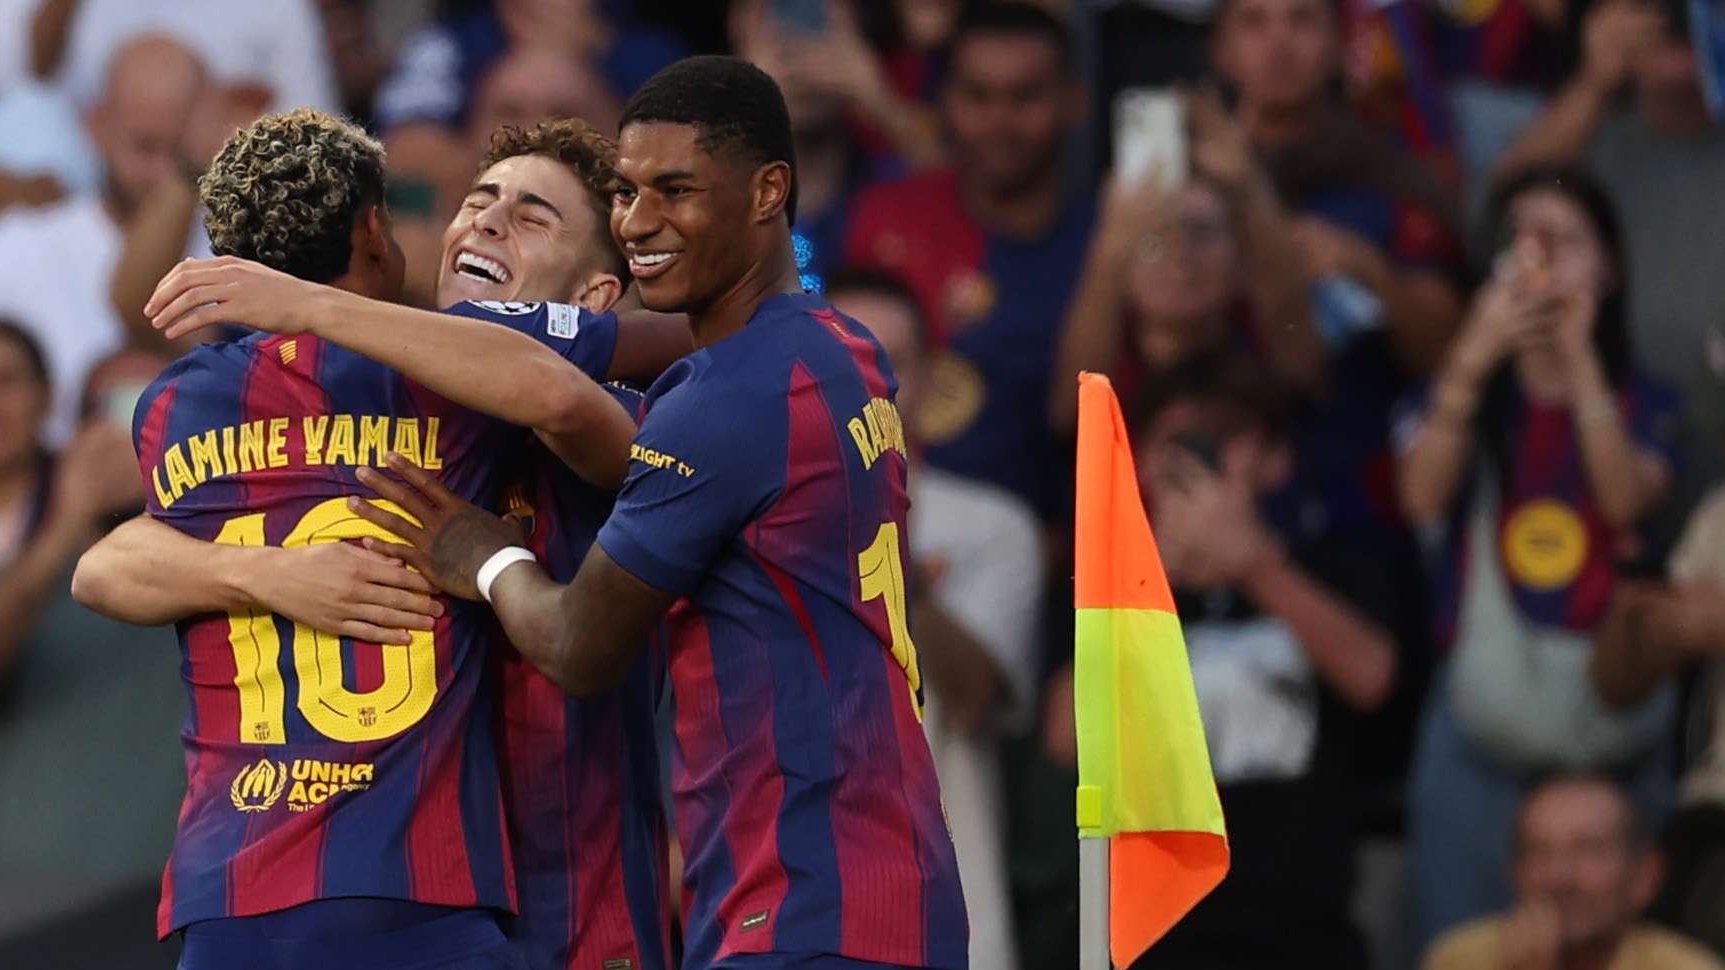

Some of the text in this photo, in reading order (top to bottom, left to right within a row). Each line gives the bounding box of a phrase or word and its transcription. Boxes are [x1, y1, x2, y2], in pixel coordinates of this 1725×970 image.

[152, 413, 443, 510] LAMINE YAMAL
[213, 496, 439, 743] 10
